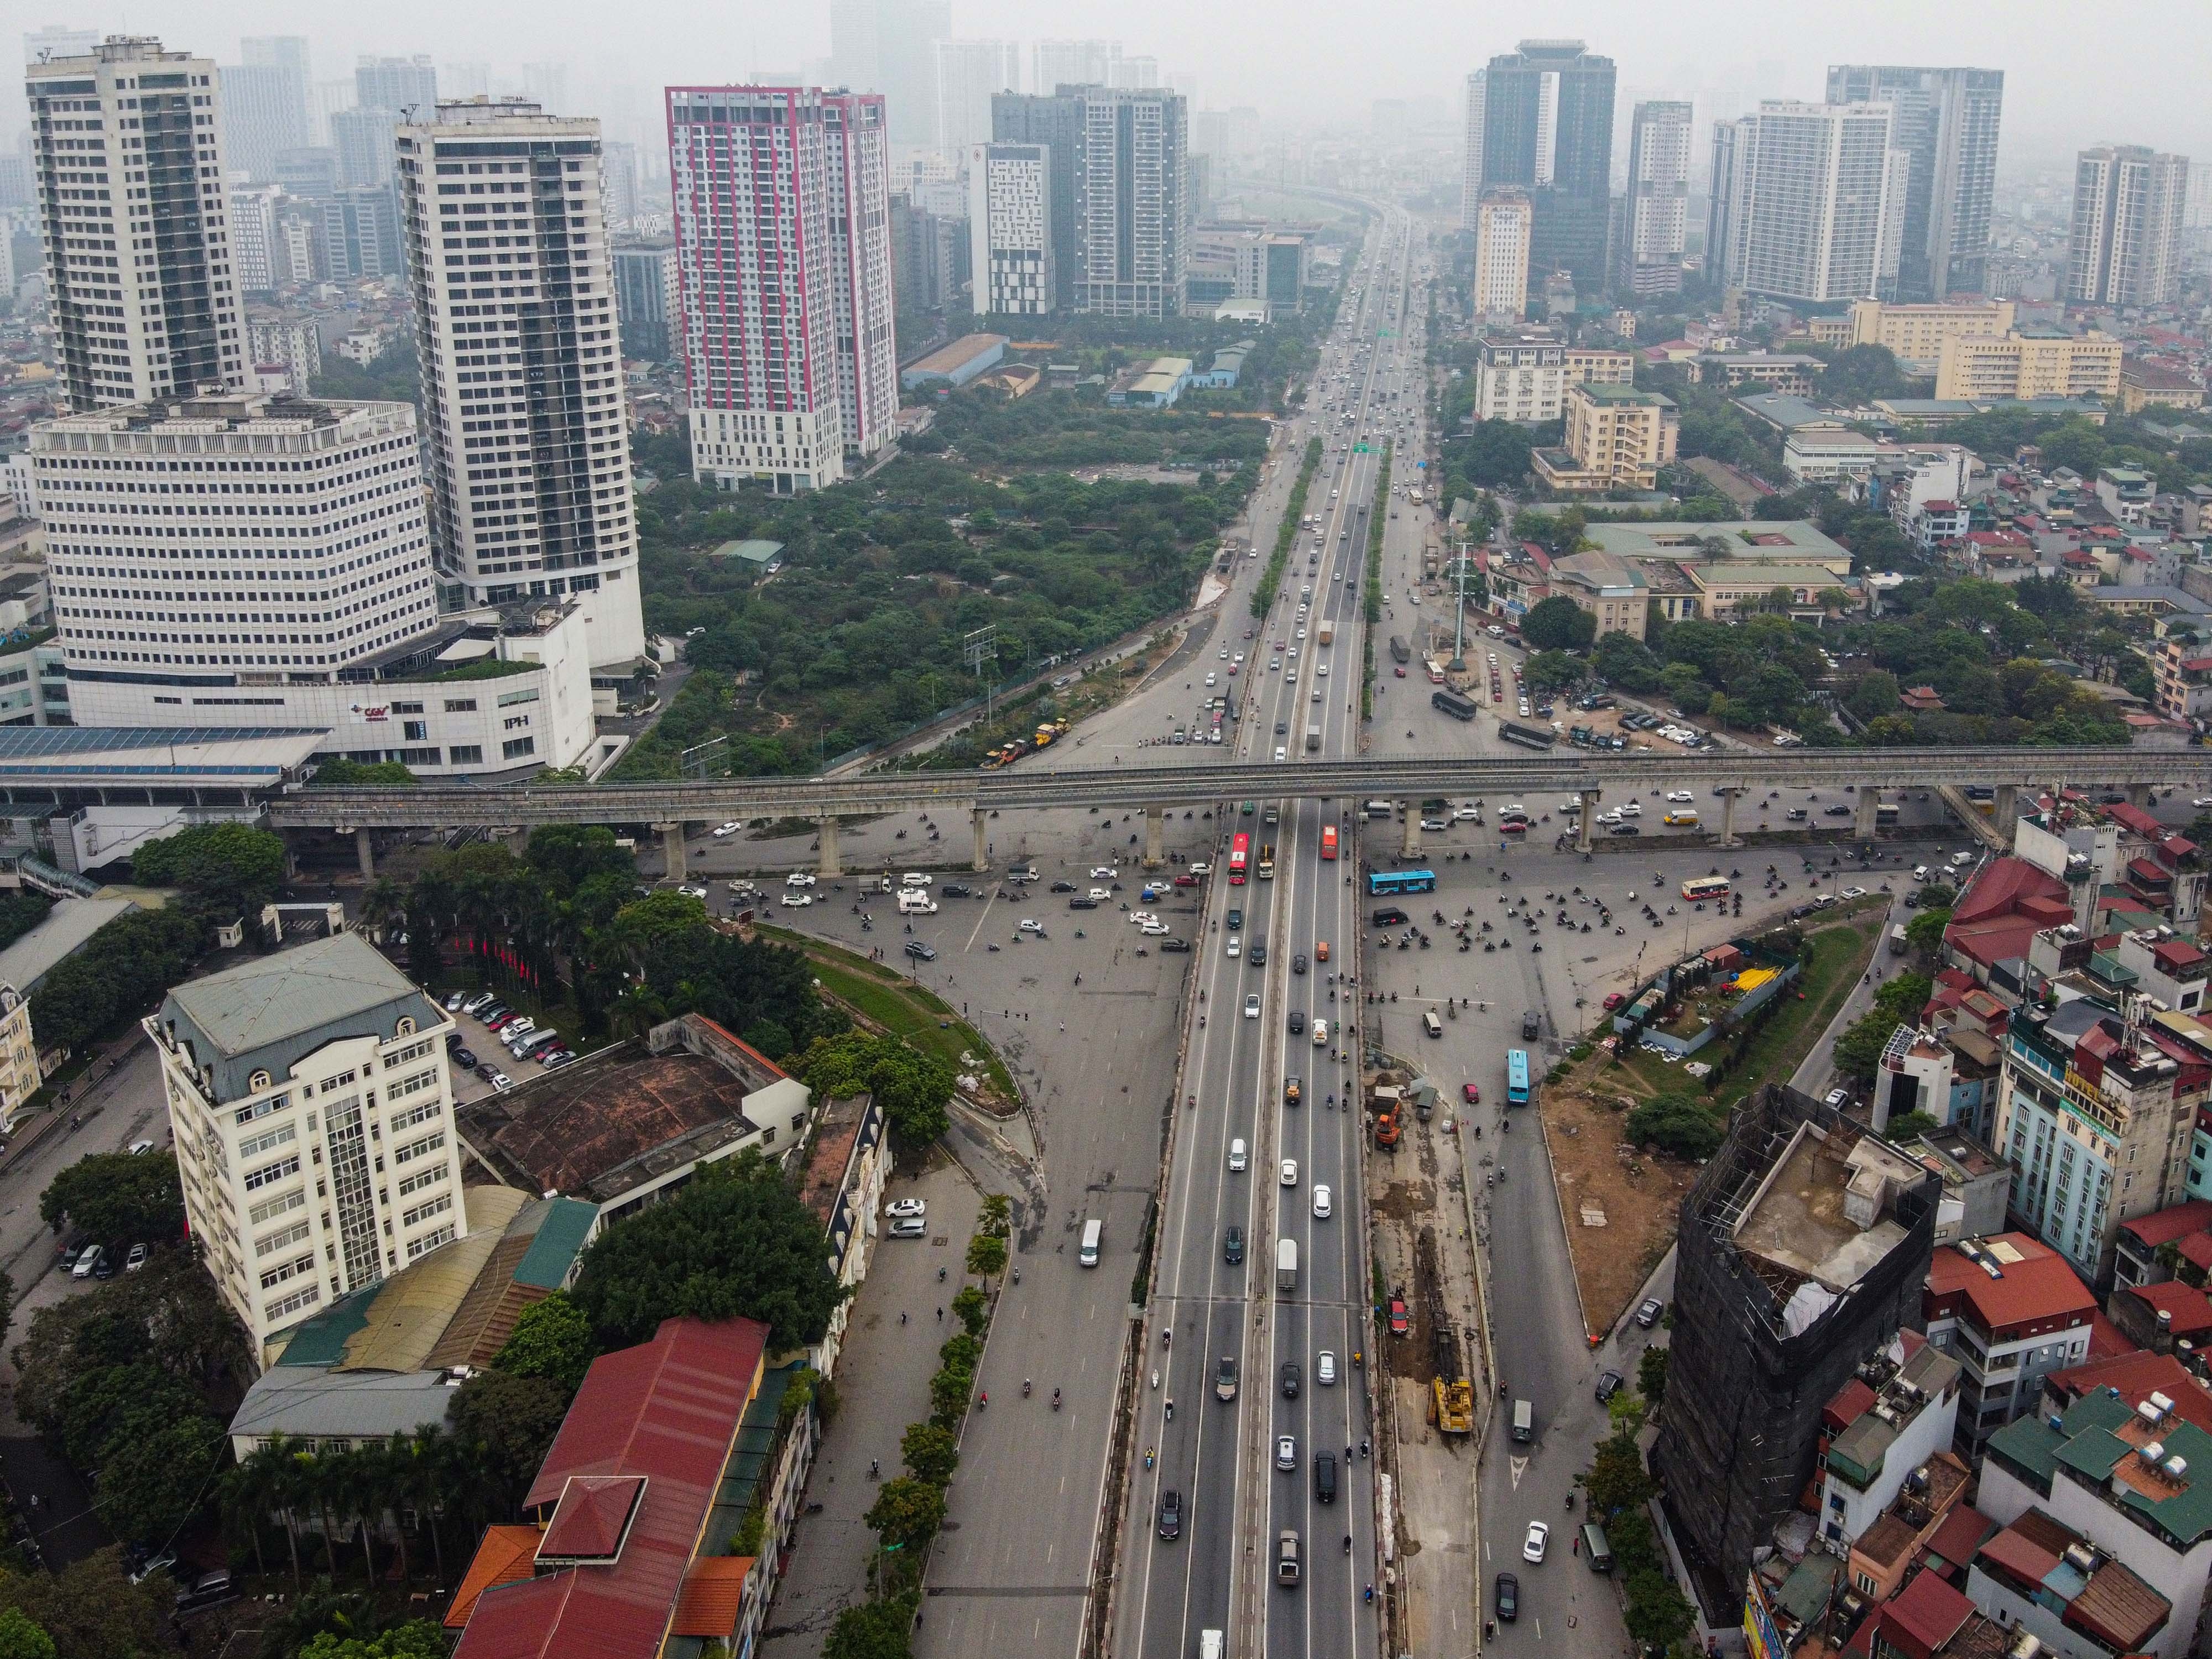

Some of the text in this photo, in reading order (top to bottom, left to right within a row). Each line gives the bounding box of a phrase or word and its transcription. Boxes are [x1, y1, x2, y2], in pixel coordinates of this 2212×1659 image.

[365, 706, 389, 716] CGV
[503, 715, 529, 729] IPH
[2065, 1067, 2100, 1101] HOTEL
